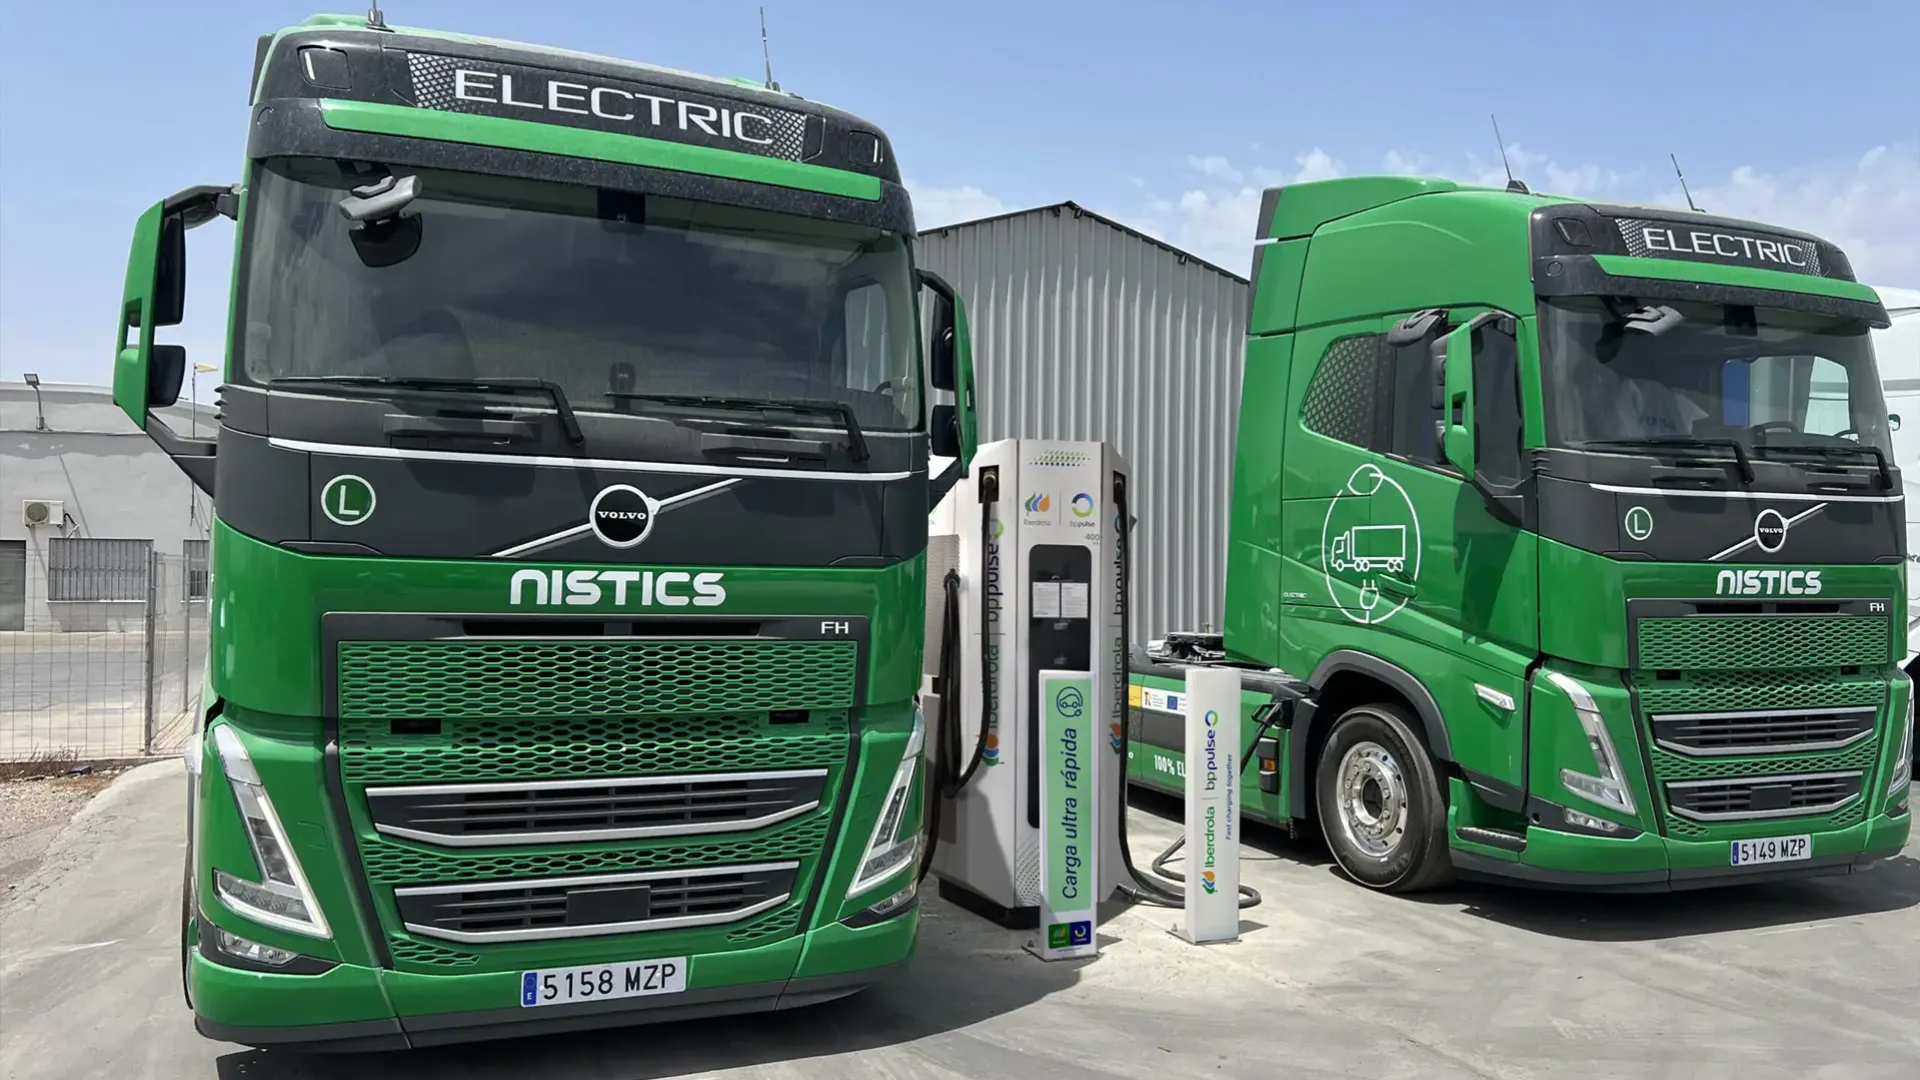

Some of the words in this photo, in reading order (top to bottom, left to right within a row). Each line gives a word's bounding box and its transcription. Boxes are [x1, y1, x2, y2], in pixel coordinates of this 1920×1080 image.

[454, 68, 773, 145] ELECTRIC
[1643, 227, 1806, 267] ELECTRIC
[338, 484, 360, 516] L
[598, 510, 647, 521] VOLVO
[1633, 513, 1646, 534] L
[510, 569, 726, 606] NISTICS
[1716, 569, 1822, 595] NISTICS
[1869, 602, 1885, 613] FH
[820, 621, 849, 634] FH
[1060, 727, 1081, 789] rápida
[1154, 754, 1175, 776] 100%
[1061, 797, 1078, 839] ultra
[1204, 806, 1216, 868] Iberdrola
[1741, 841, 1776, 862] 5149
[1780, 838, 1806, 858] MZP
[1062, 845, 1081, 900] Carga
[526, 992, 533, 1000] E
[543, 969, 614, 1000] 5158
[624, 963, 676, 992] MZP
